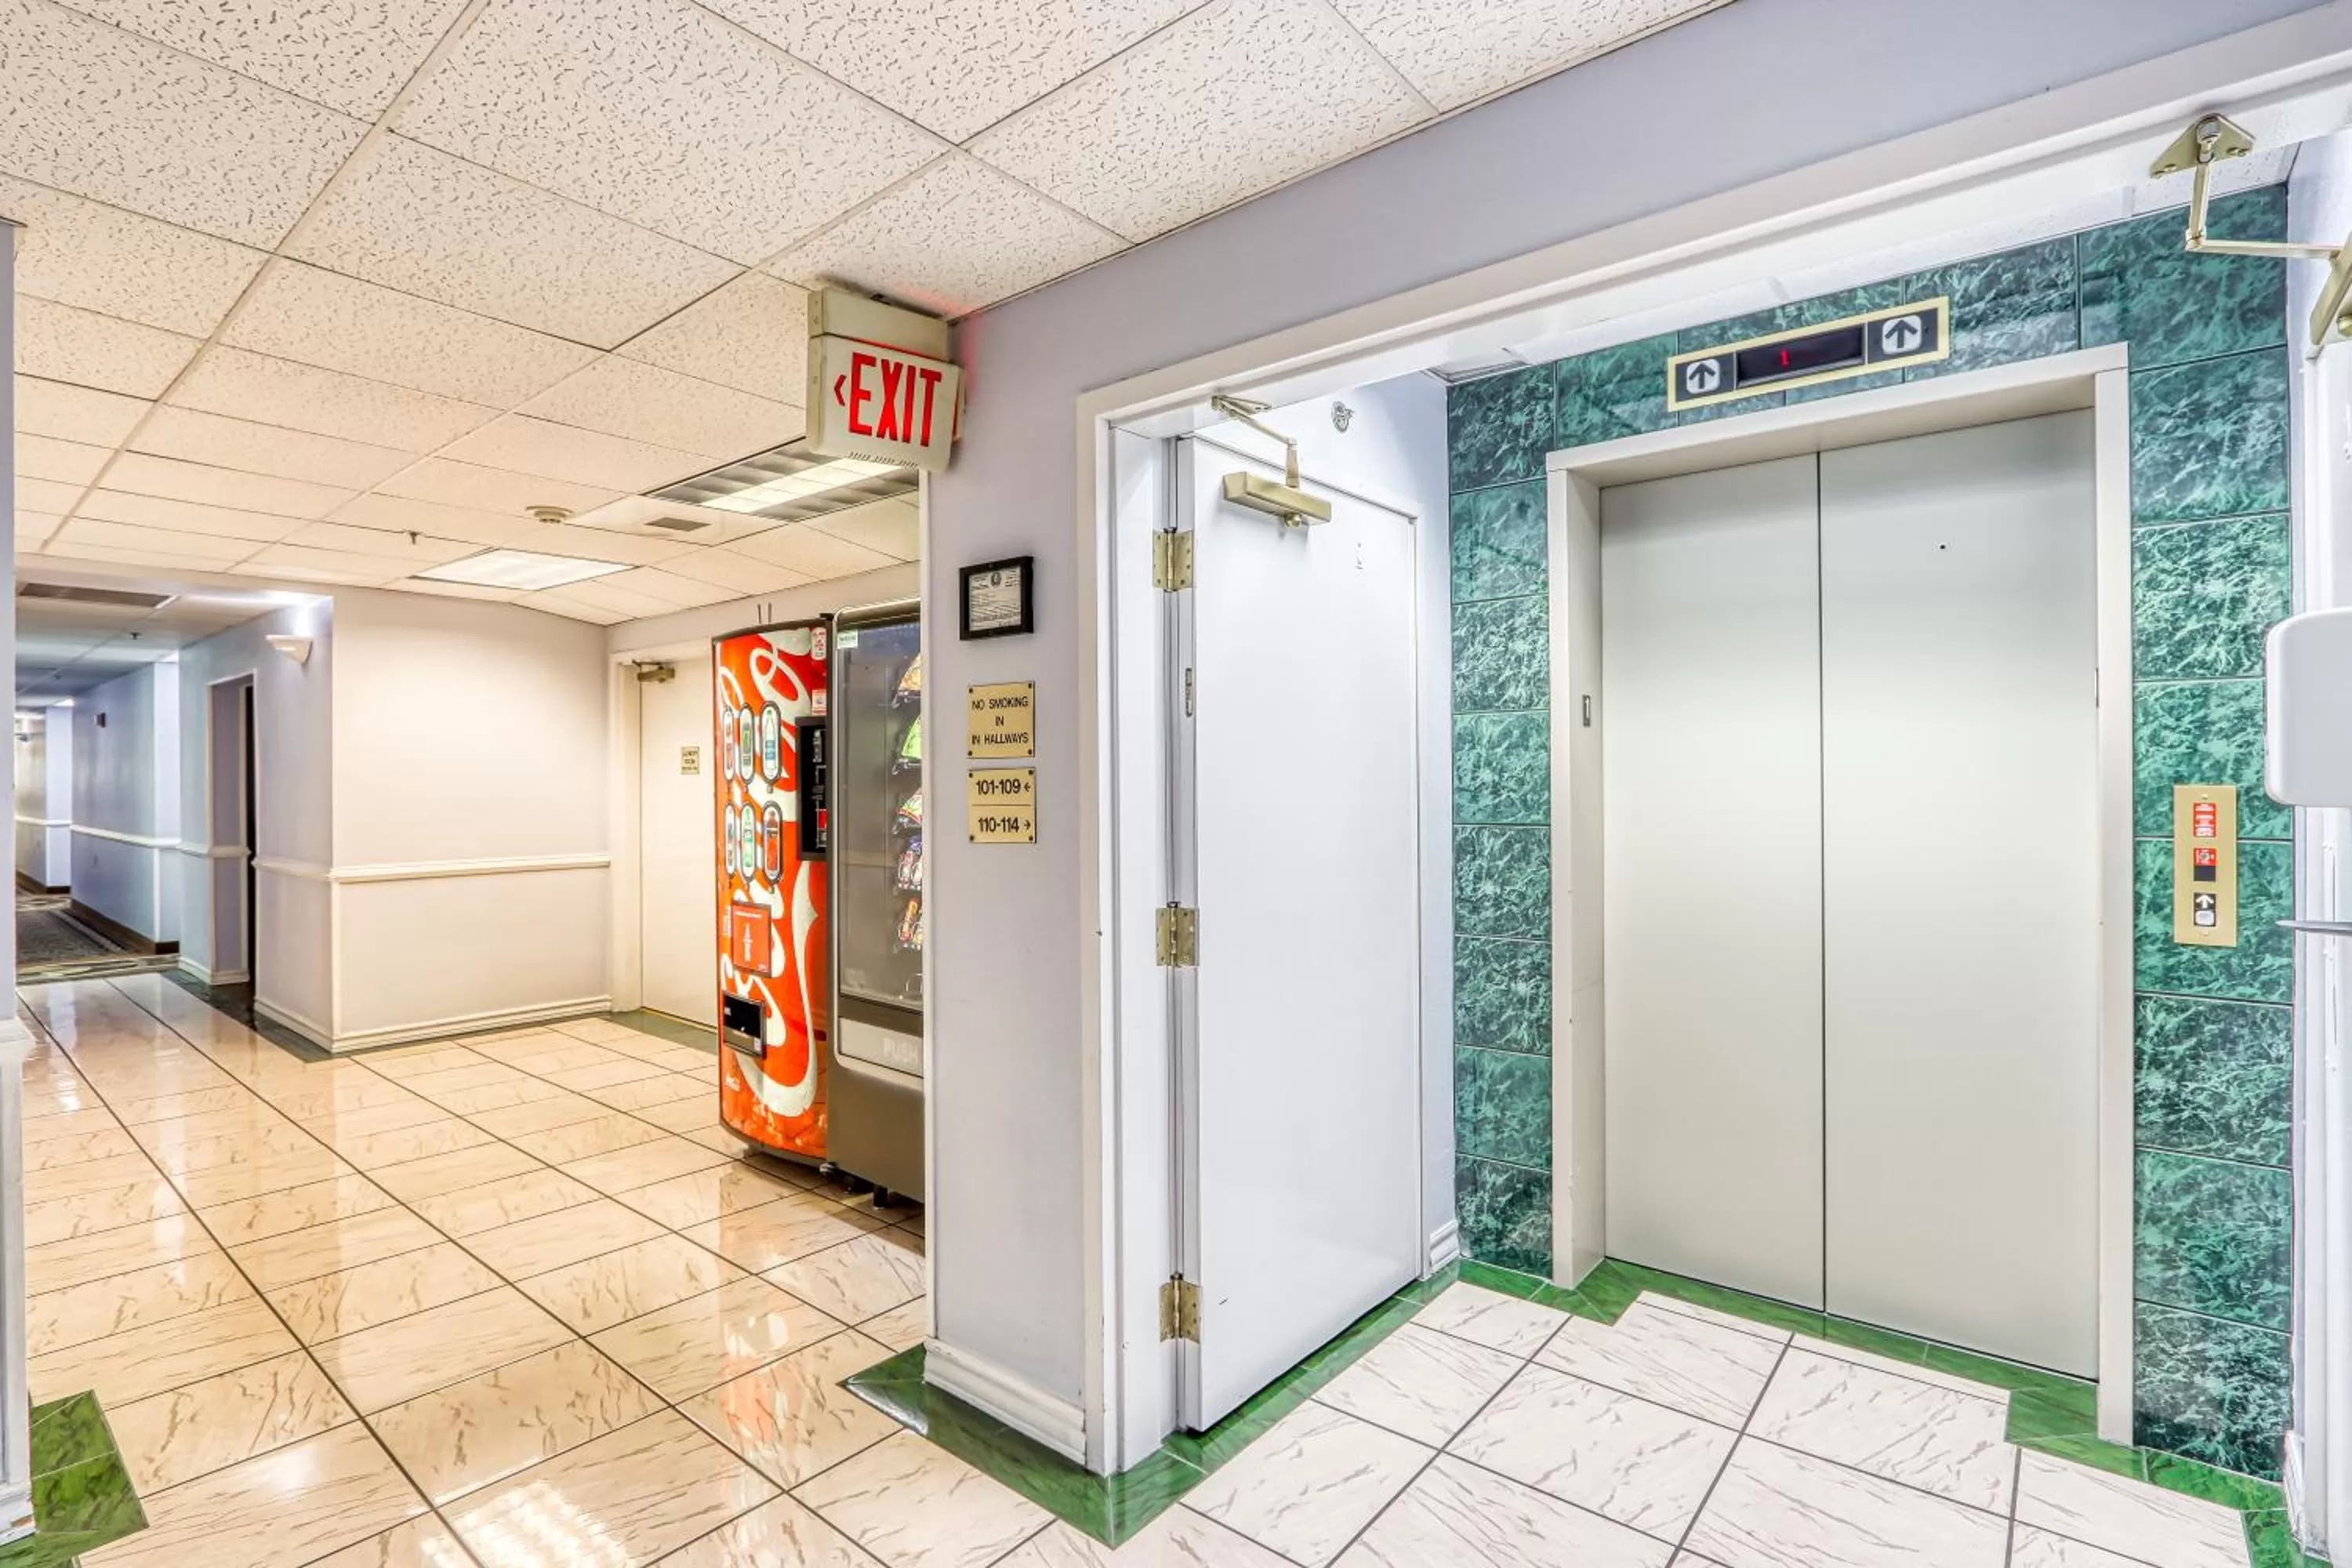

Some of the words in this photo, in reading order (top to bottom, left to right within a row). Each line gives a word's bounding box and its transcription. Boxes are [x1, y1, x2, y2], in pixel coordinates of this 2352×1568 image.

[848, 351, 942, 448] EXIT
[971, 699, 985, 710] NO
[989, 696, 1029, 710] SMOKING
[995, 716, 1004, 727] IN
[971, 734, 981, 746] IN
[984, 731, 1029, 745] HALLWAYS
[975, 779, 1022, 795] 101-109
[978, 817, 1020, 833] 110-114
